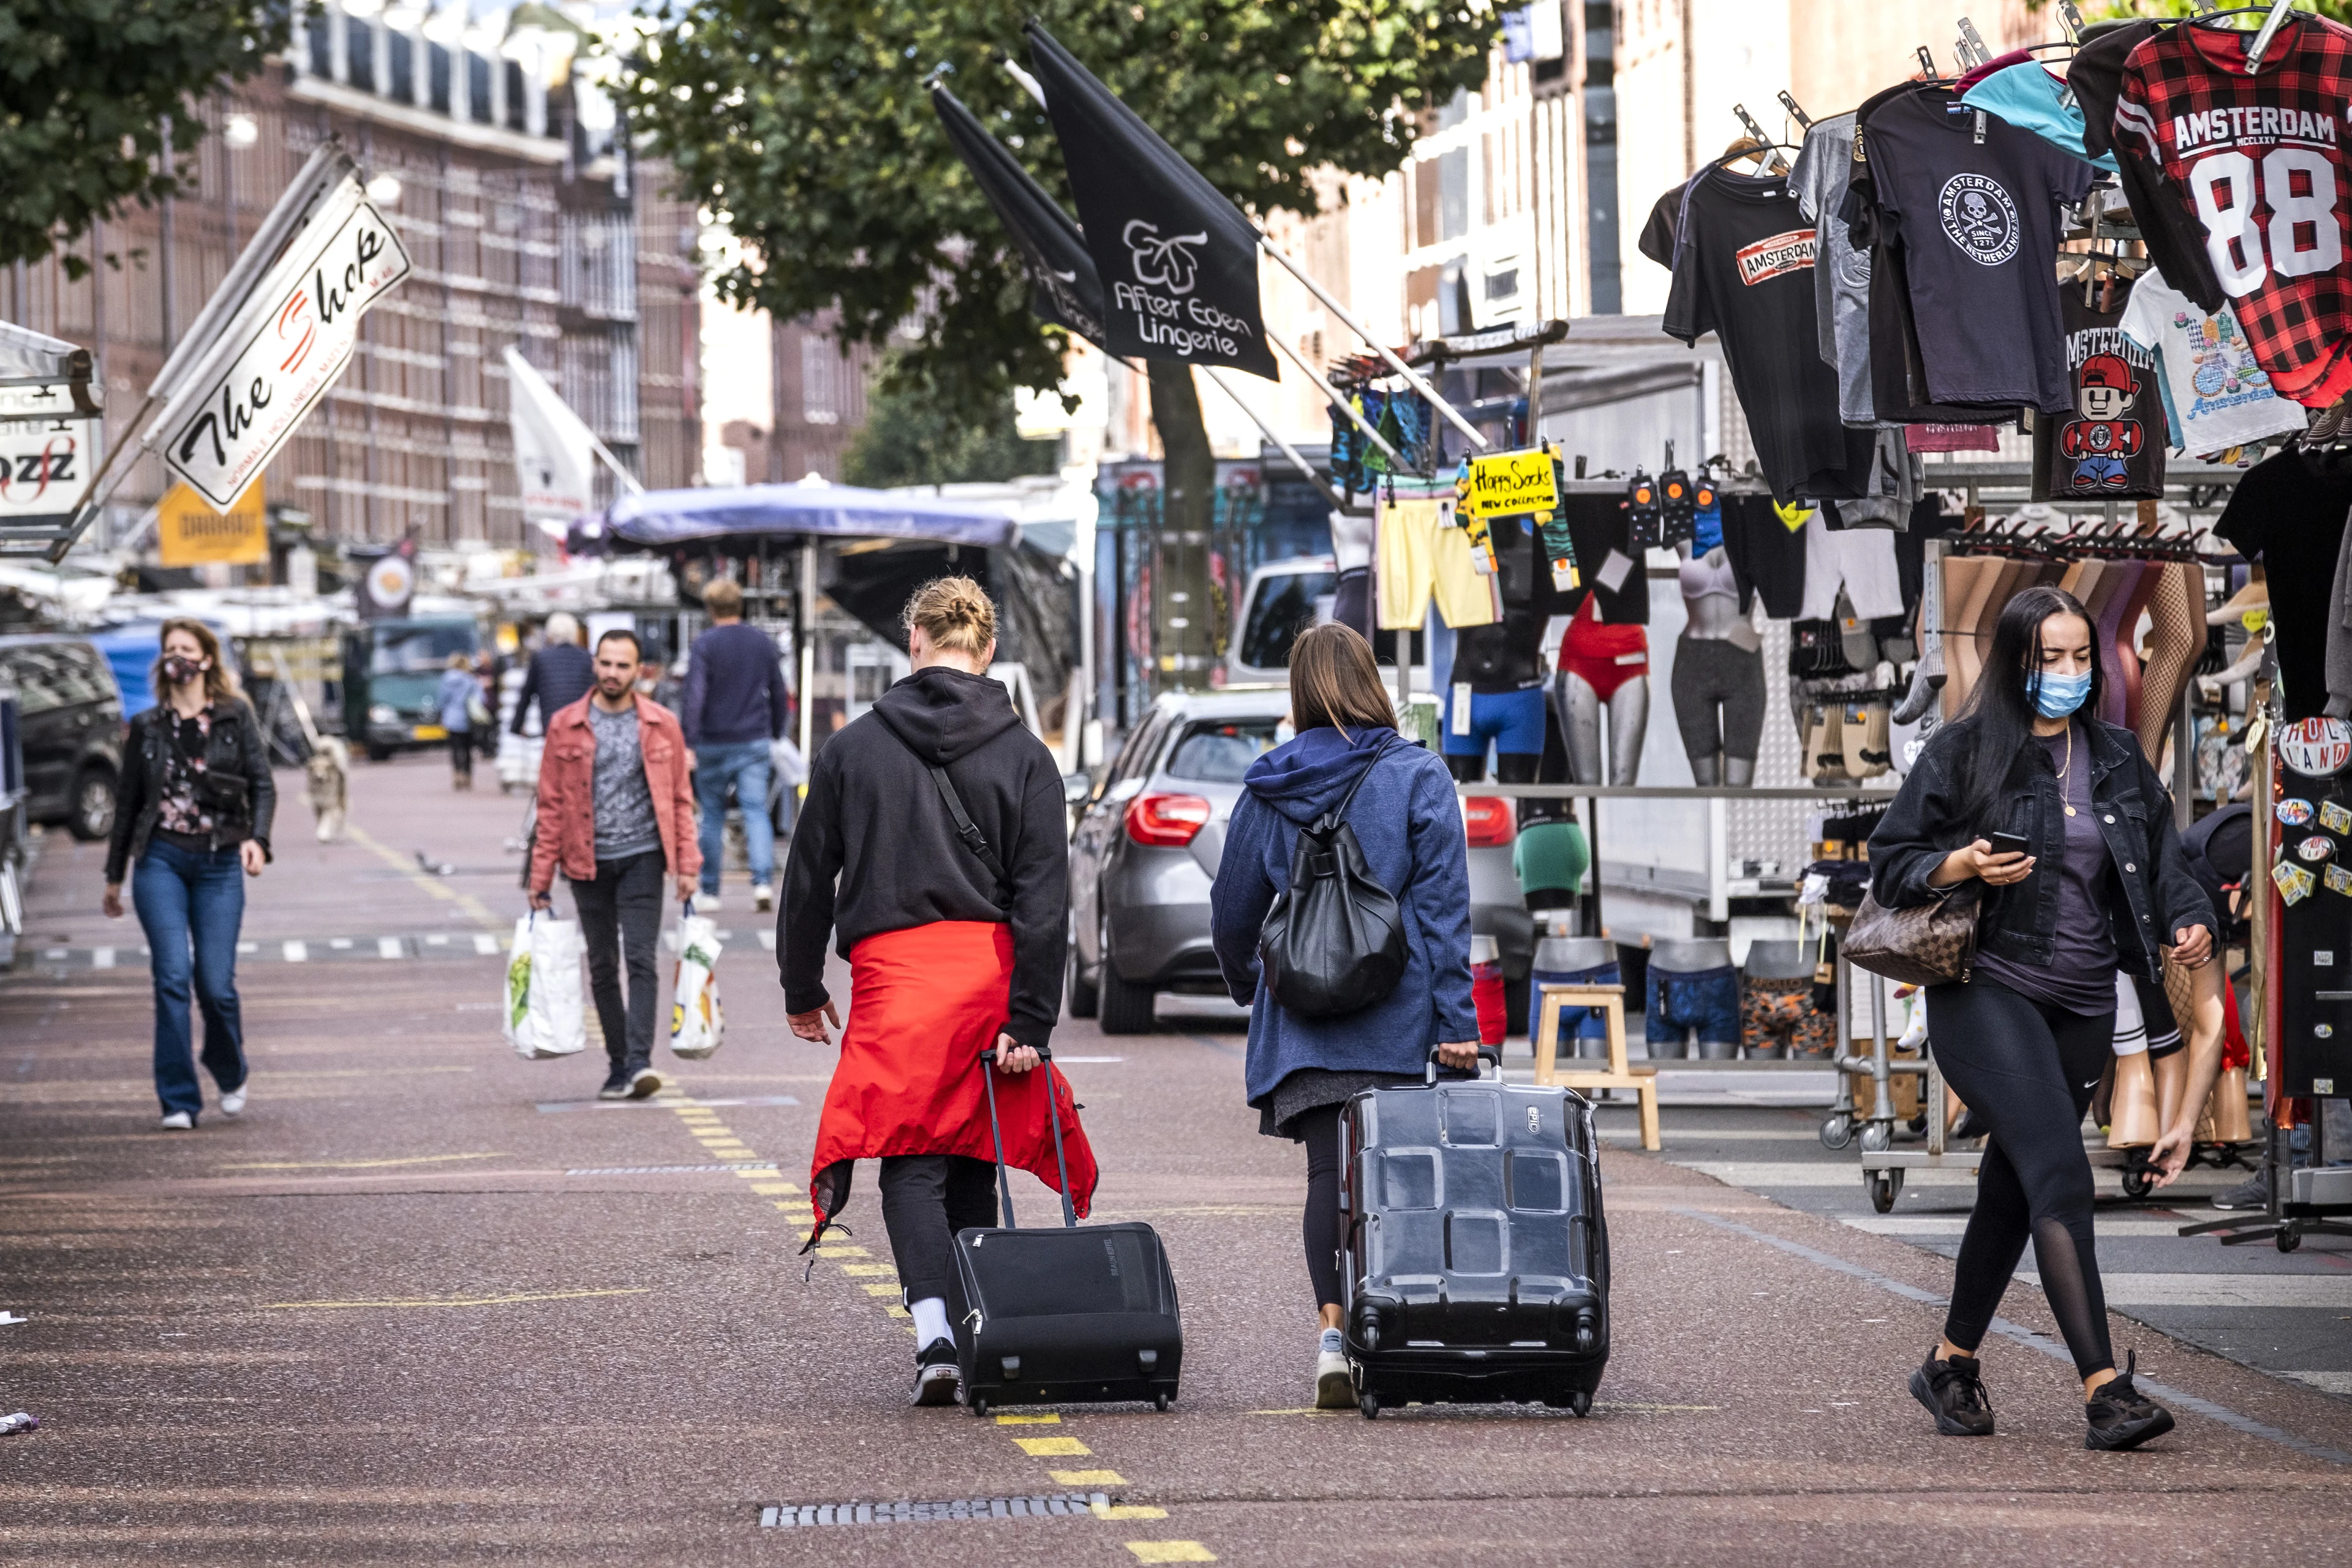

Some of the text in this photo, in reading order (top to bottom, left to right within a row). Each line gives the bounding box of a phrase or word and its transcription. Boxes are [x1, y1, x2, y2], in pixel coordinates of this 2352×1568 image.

[2174, 107, 2337, 149] AMSTERDAM
[2236, 136, 2276, 146] MCCLXXV
[1943, 177, 2012, 208] AMSTERDAM
[1948, 222, 1967, 245] THE
[2190, 148, 2343, 298] 88
[1966, 225, 2018, 262] NETHERLANDS
[1114, 281, 1253, 338] After Eden
[179, 376, 273, 467] The
[277, 227, 386, 374] Shop
[1138, 312, 1238, 356] Lingerie
[1474, 460, 1551, 493] Happy Socks
[1481, 499, 1502, 510] NEW
[2286, 744, 2345, 770] LAND
